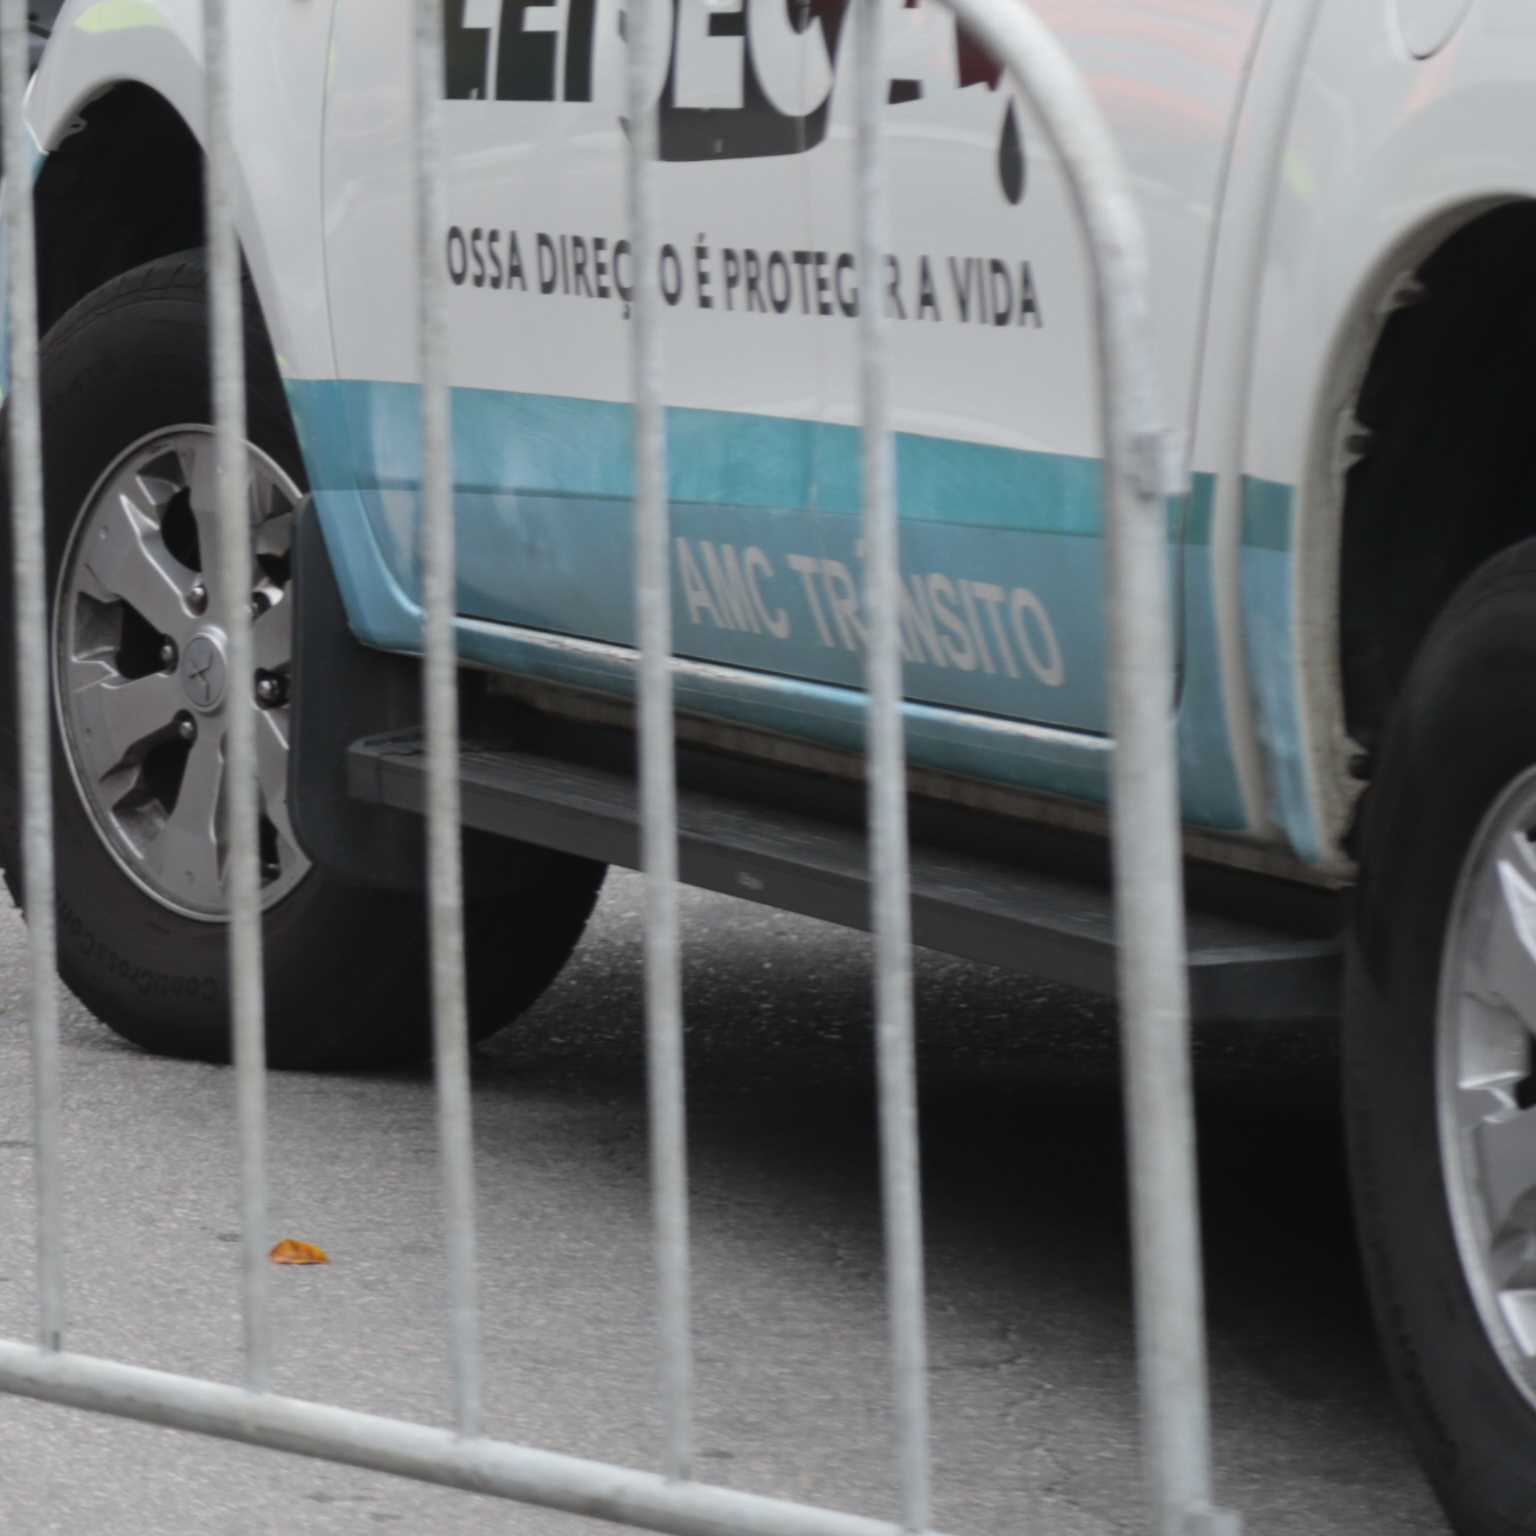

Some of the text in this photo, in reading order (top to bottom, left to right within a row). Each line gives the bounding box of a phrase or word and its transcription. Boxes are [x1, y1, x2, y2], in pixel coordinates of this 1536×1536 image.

[446, 226, 1043, 329] OSSA DIREÇO É PROTEGR A VIDA
[675, 537, 1065, 687] AMC TRNSITO
